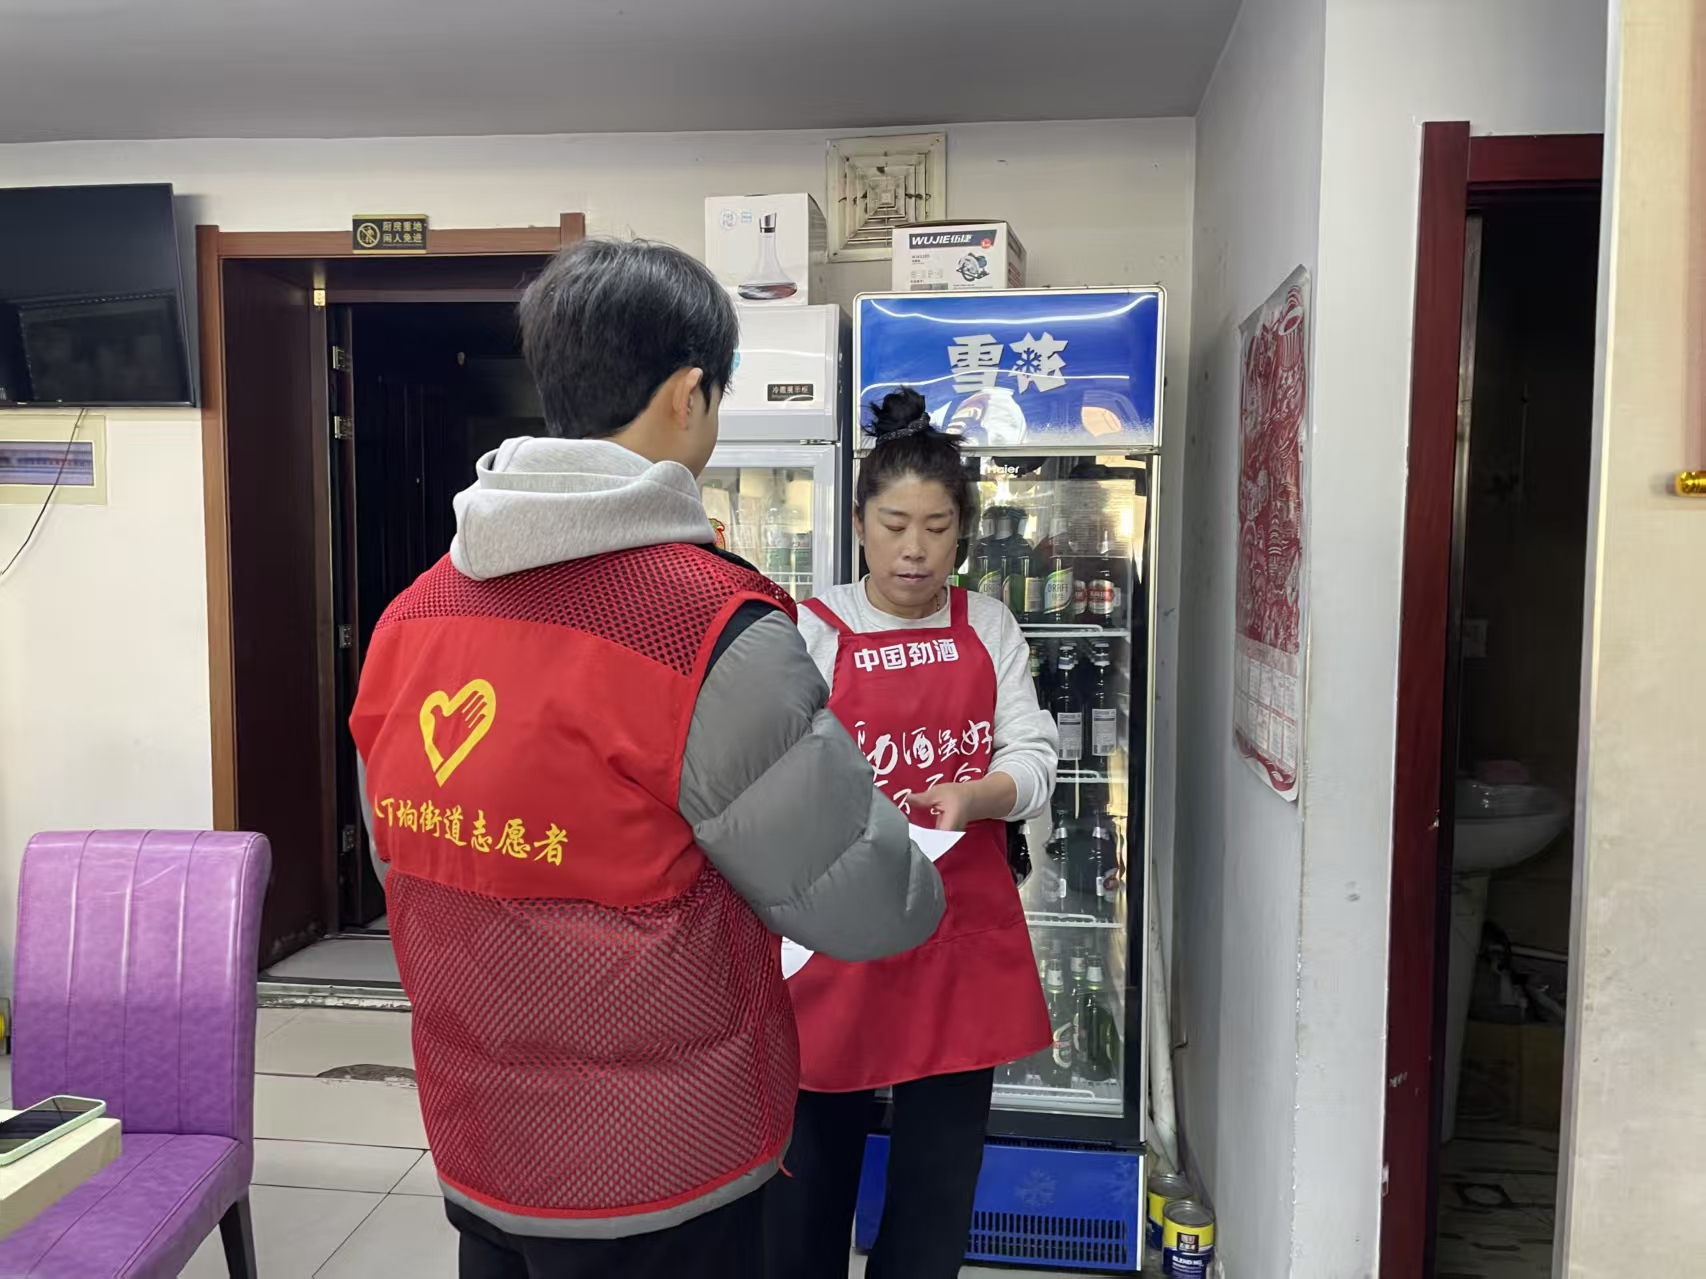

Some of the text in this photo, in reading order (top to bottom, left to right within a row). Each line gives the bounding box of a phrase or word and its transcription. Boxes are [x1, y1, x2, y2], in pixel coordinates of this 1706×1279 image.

[947, 331, 1068, 394] 雪花
[988, 464, 1020, 475] Haier
[854, 638, 959, 672] 中国劲酒
